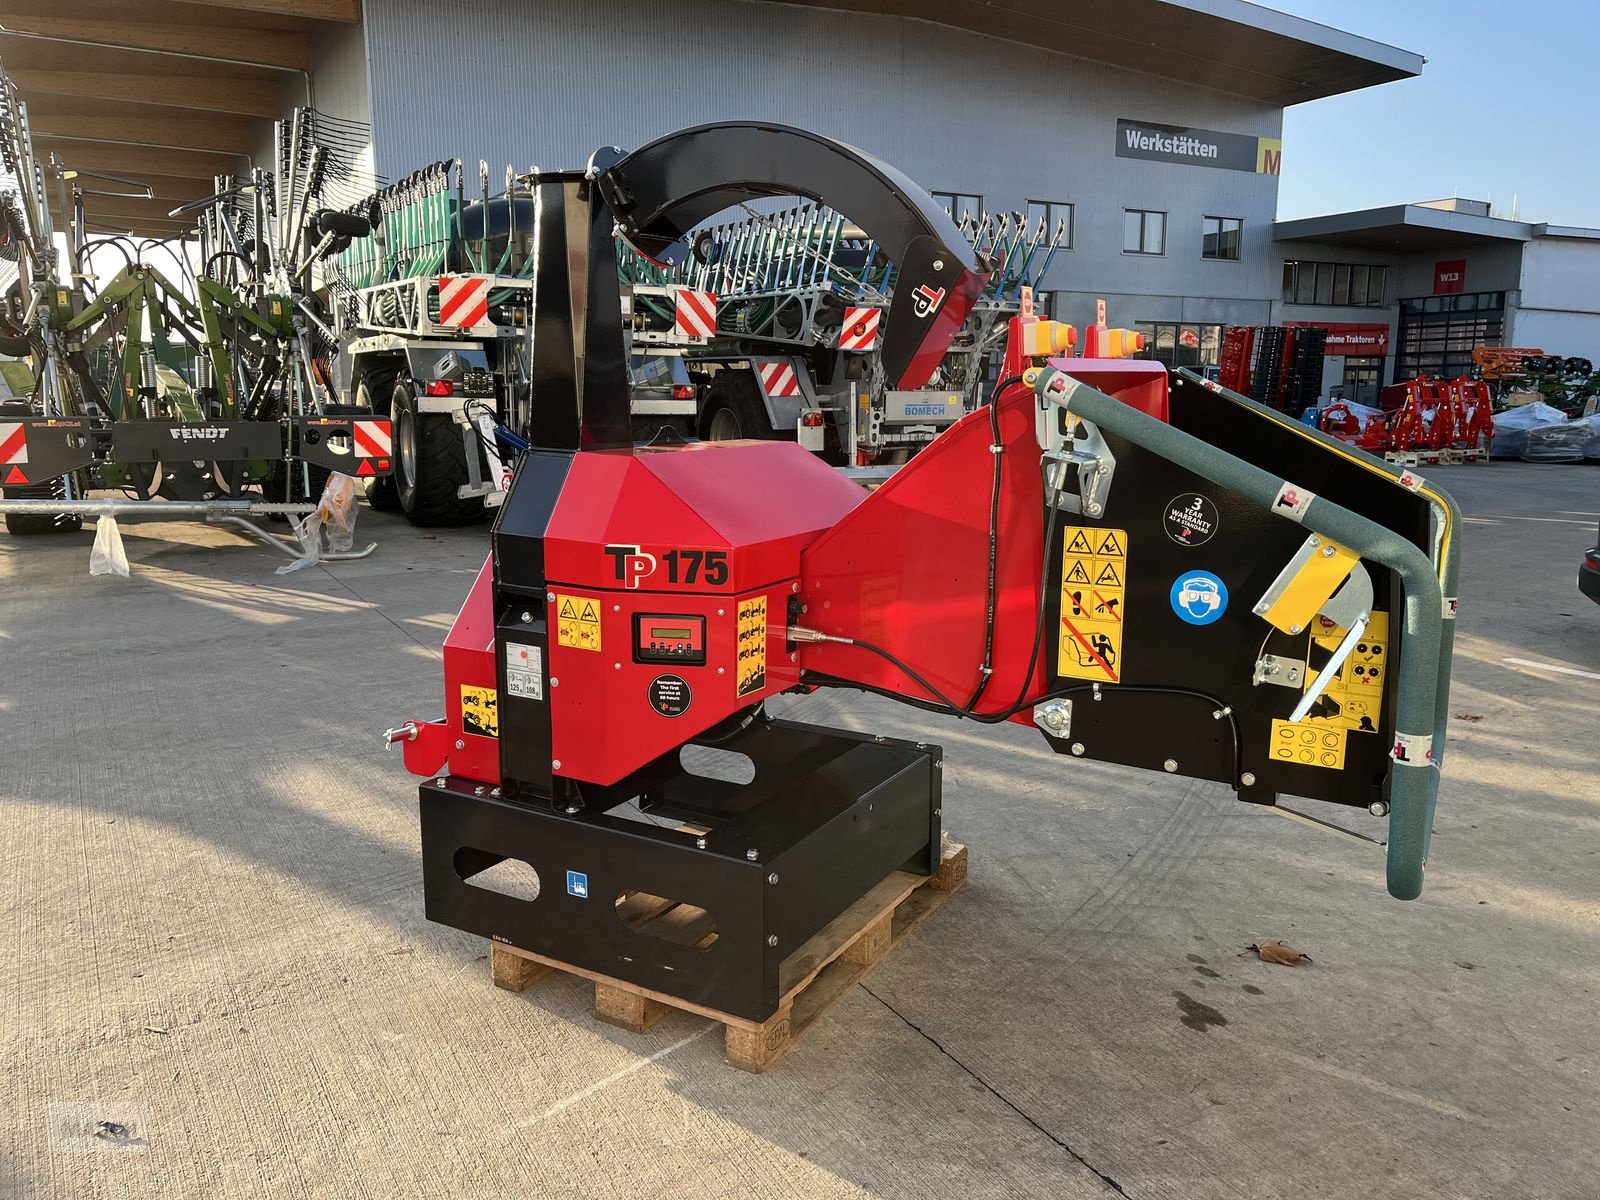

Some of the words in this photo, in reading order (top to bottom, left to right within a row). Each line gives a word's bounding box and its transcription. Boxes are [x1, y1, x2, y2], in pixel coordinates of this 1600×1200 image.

[1125, 129, 1218, 158] Werkstätten
[1263, 149, 1281, 176] M
[1440, 272, 1459, 282] W13
[911, 284, 946, 318] TP
[1345, 335, 1375, 344] Traktoren
[1047, 378, 1066, 394] TP
[904, 406, 945, 416] BOMECH
[169, 428, 230, 439] FENDT
[1191, 497, 1203, 511] 3
[1277, 490, 1299, 508] TP
[1172, 509, 1211, 528] WARRANTY
[1184, 507, 1203, 519] YEAR
[1181, 520, 1209, 534] STANDARD
[604, 543, 657, 589] TP
[662, 549, 729, 586] 175
[510, 683, 520, 692] 125
[526, 686, 536, 695] 108
